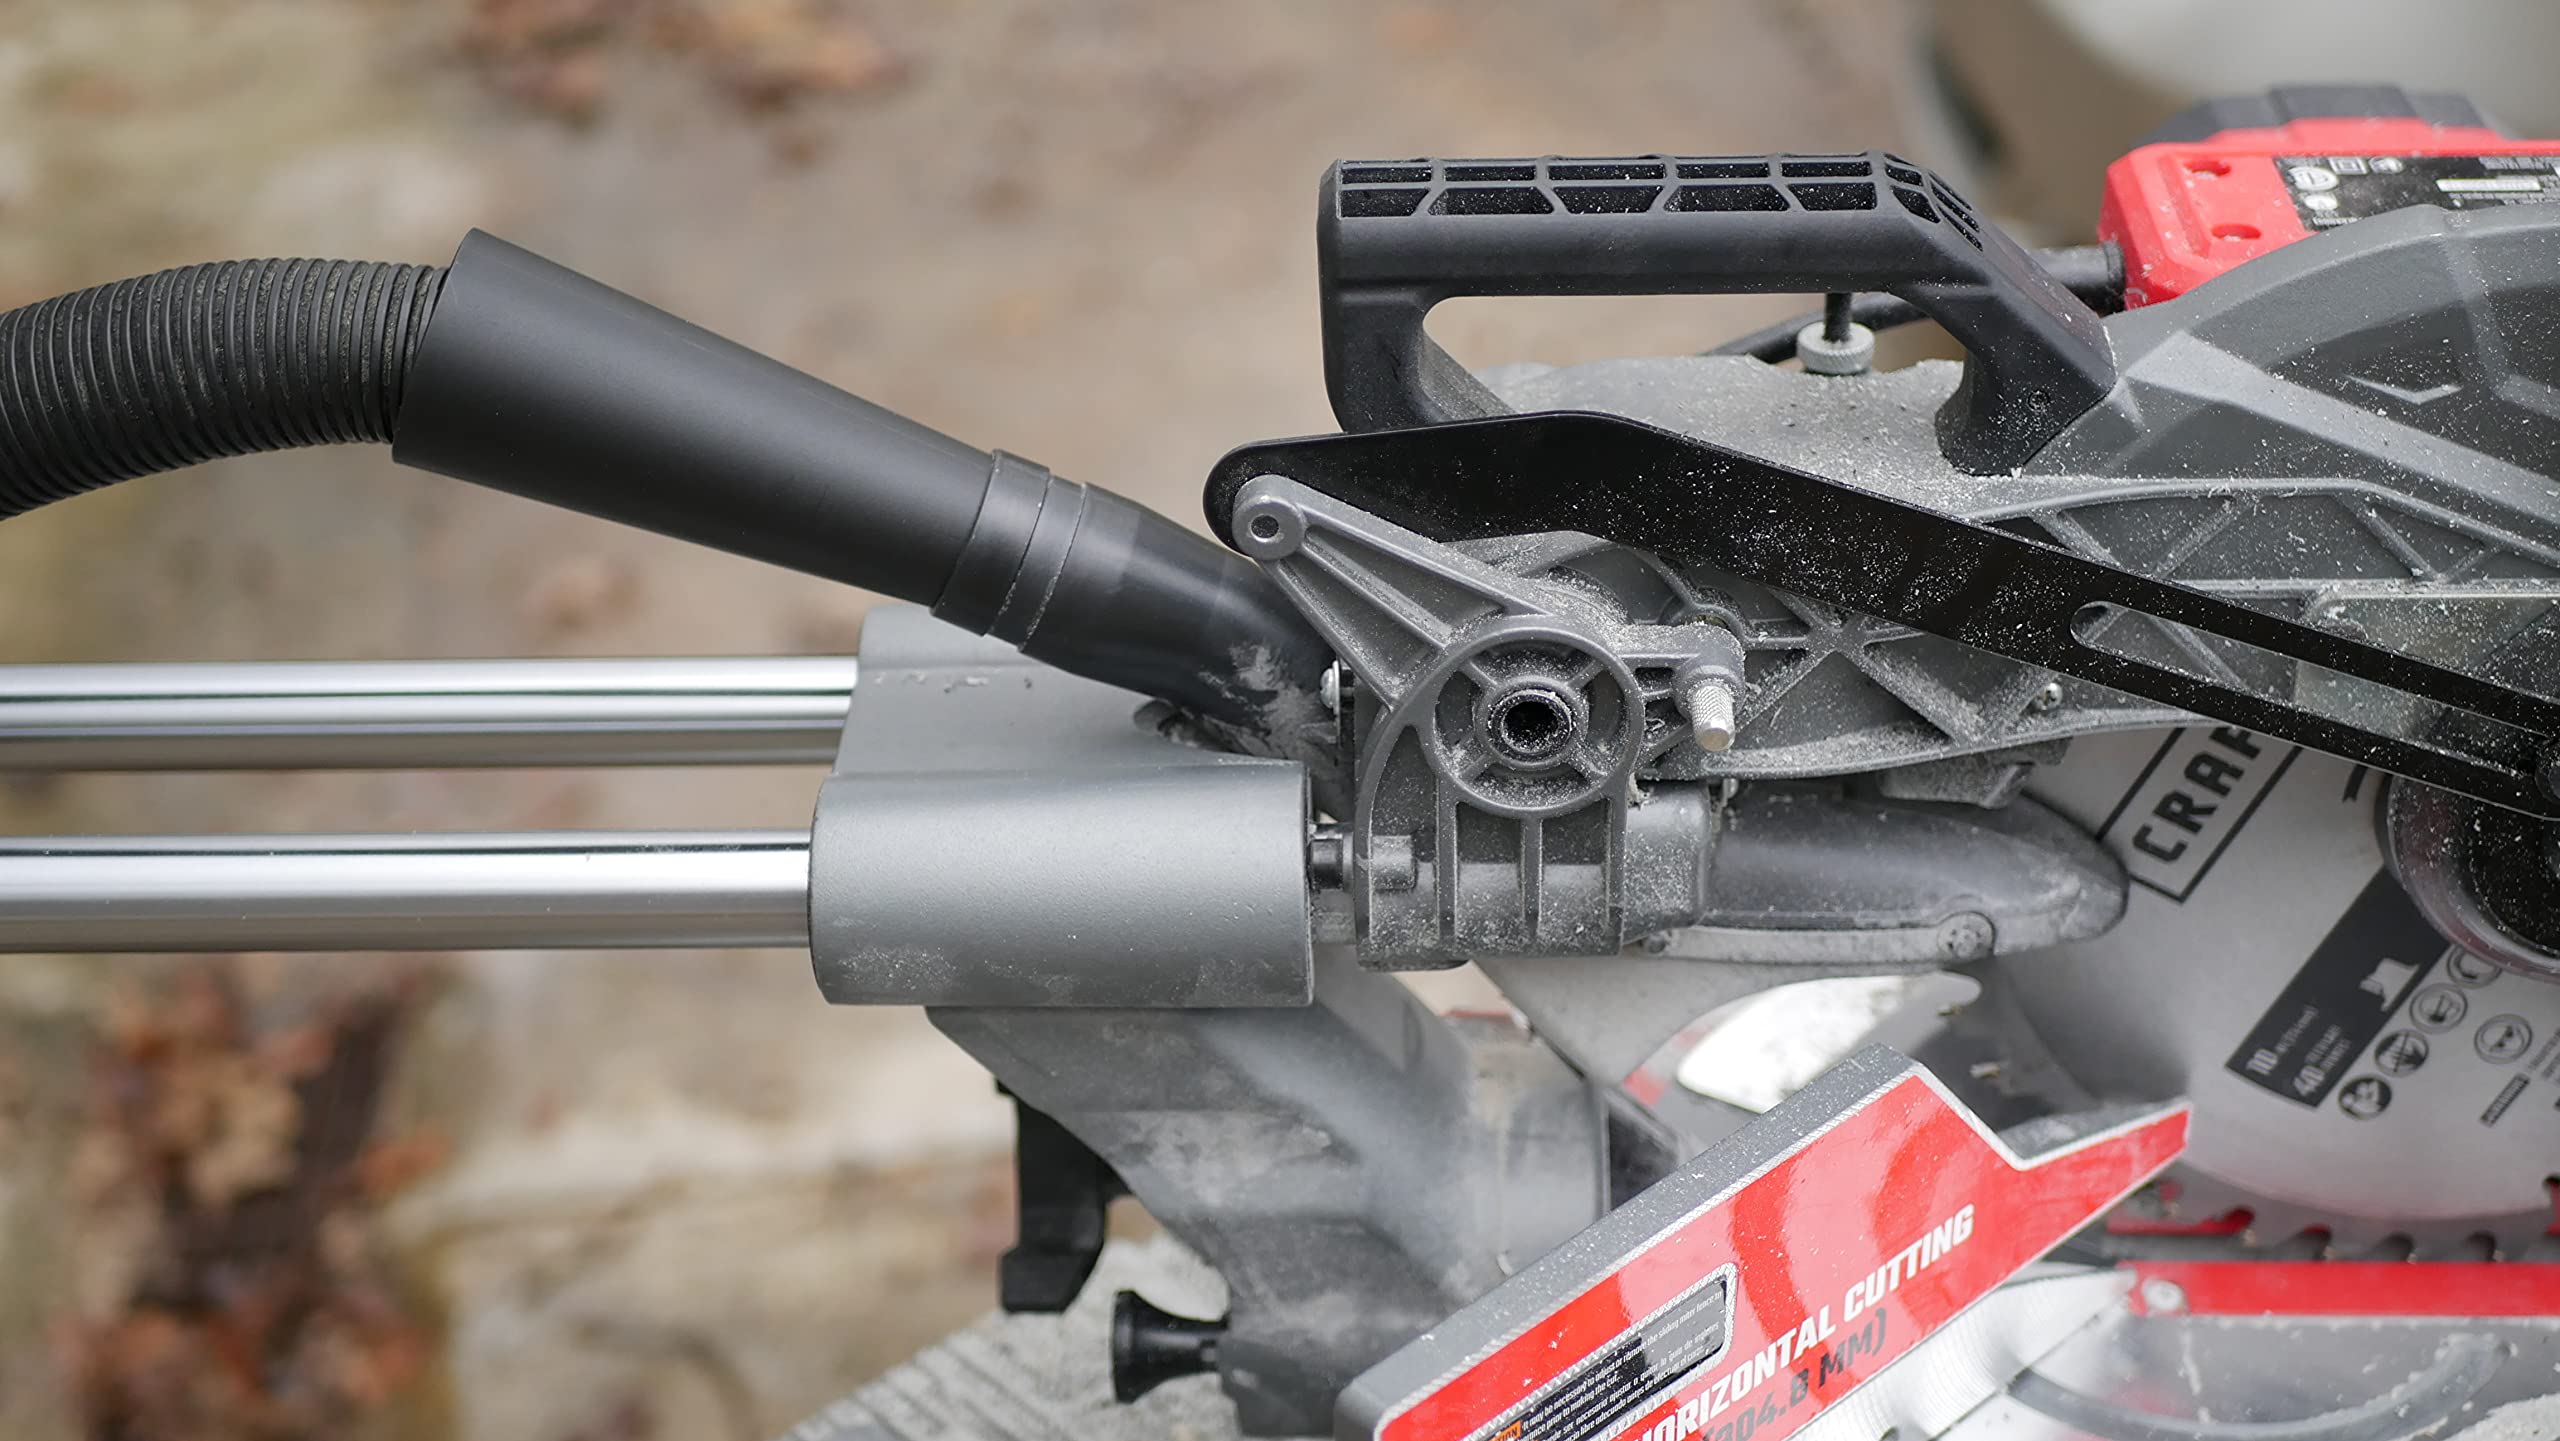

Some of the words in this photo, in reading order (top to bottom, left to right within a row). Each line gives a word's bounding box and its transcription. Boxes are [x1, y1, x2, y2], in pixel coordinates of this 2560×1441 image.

[1844, 1203, 1975, 1323] CUTTING
[1529, 1411, 1544, 1427] may
[1553, 1381, 1587, 1410] necessary
[1595, 1361, 1615, 1382] adjust
[1623, 1344, 1646, 1364] remove
[1647, 1335, 1658, 1347] the
[1658, 1319, 1679, 1339] sliding
[1819, 1307, 1887, 1388] MM)
[1547, 1414, 1562, 1429] prior
[1570, 1391, 1595, 1413] making
